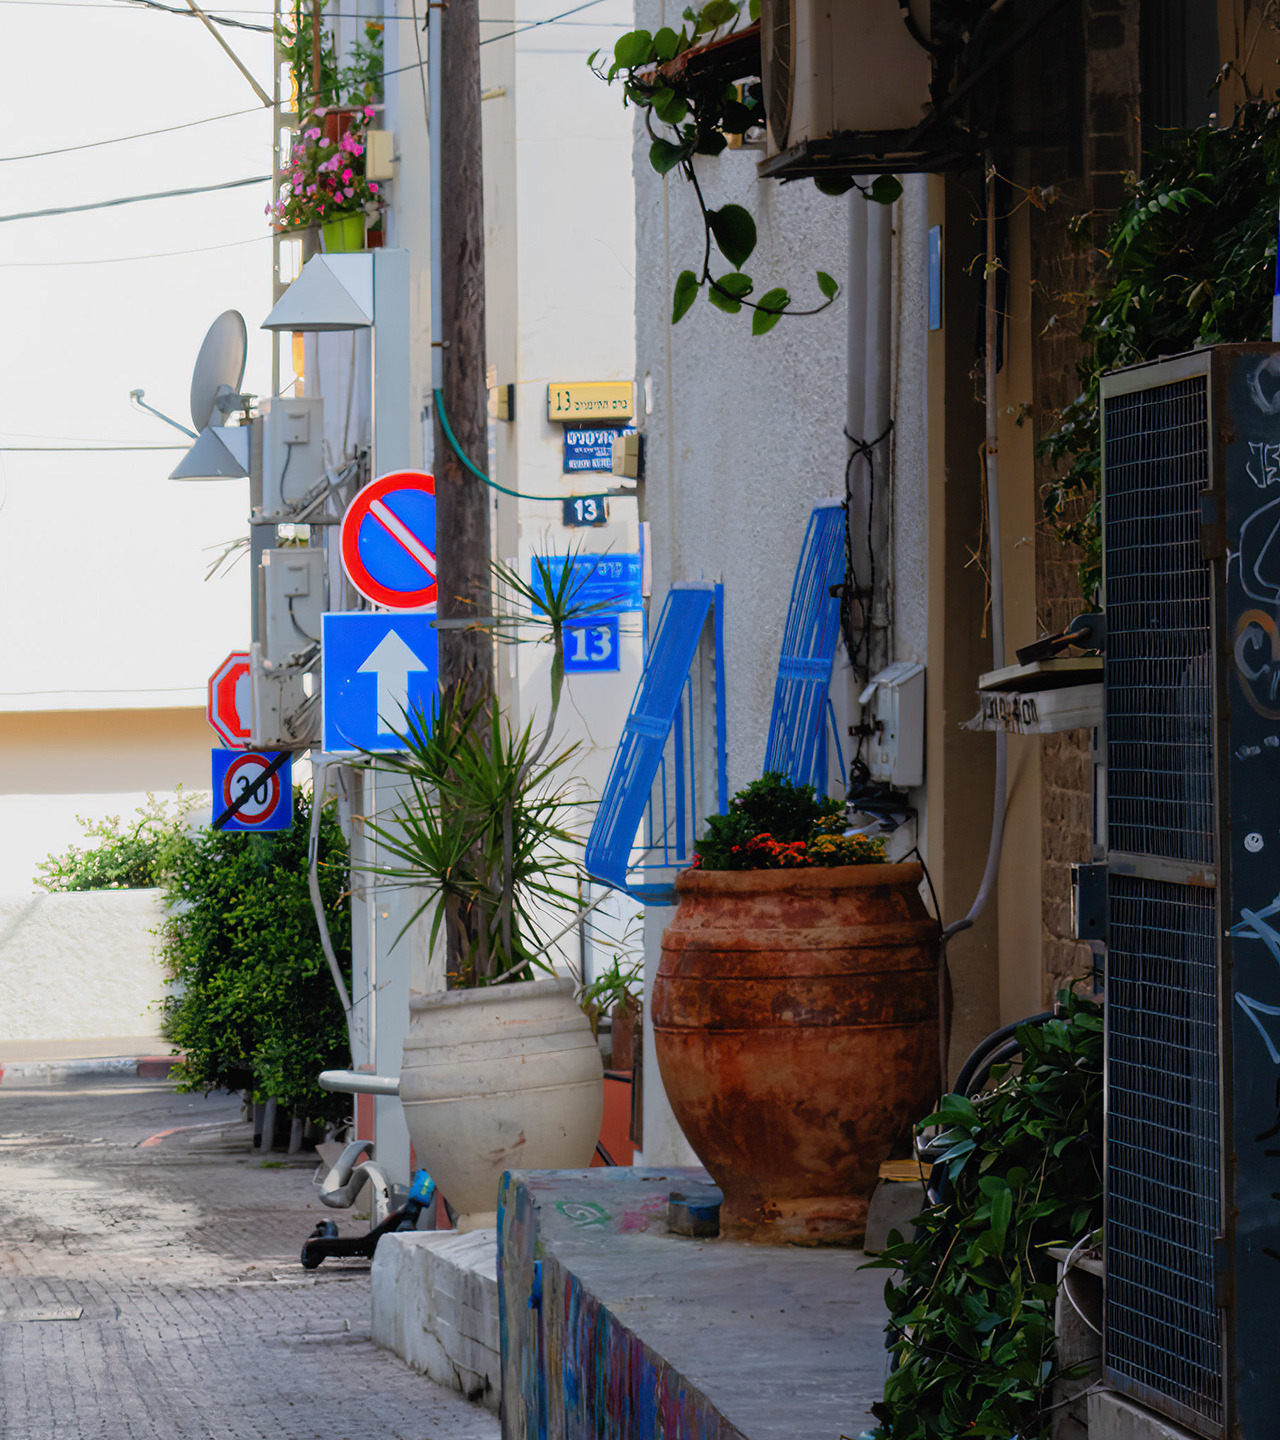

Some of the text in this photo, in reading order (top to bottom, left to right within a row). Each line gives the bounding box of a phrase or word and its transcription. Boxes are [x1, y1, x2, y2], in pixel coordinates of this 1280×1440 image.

[556, 391, 571, 411] 13
[573, 498, 598, 522] 13
[570, 625, 613, 662] 13
[234, 774, 269, 806] 30
